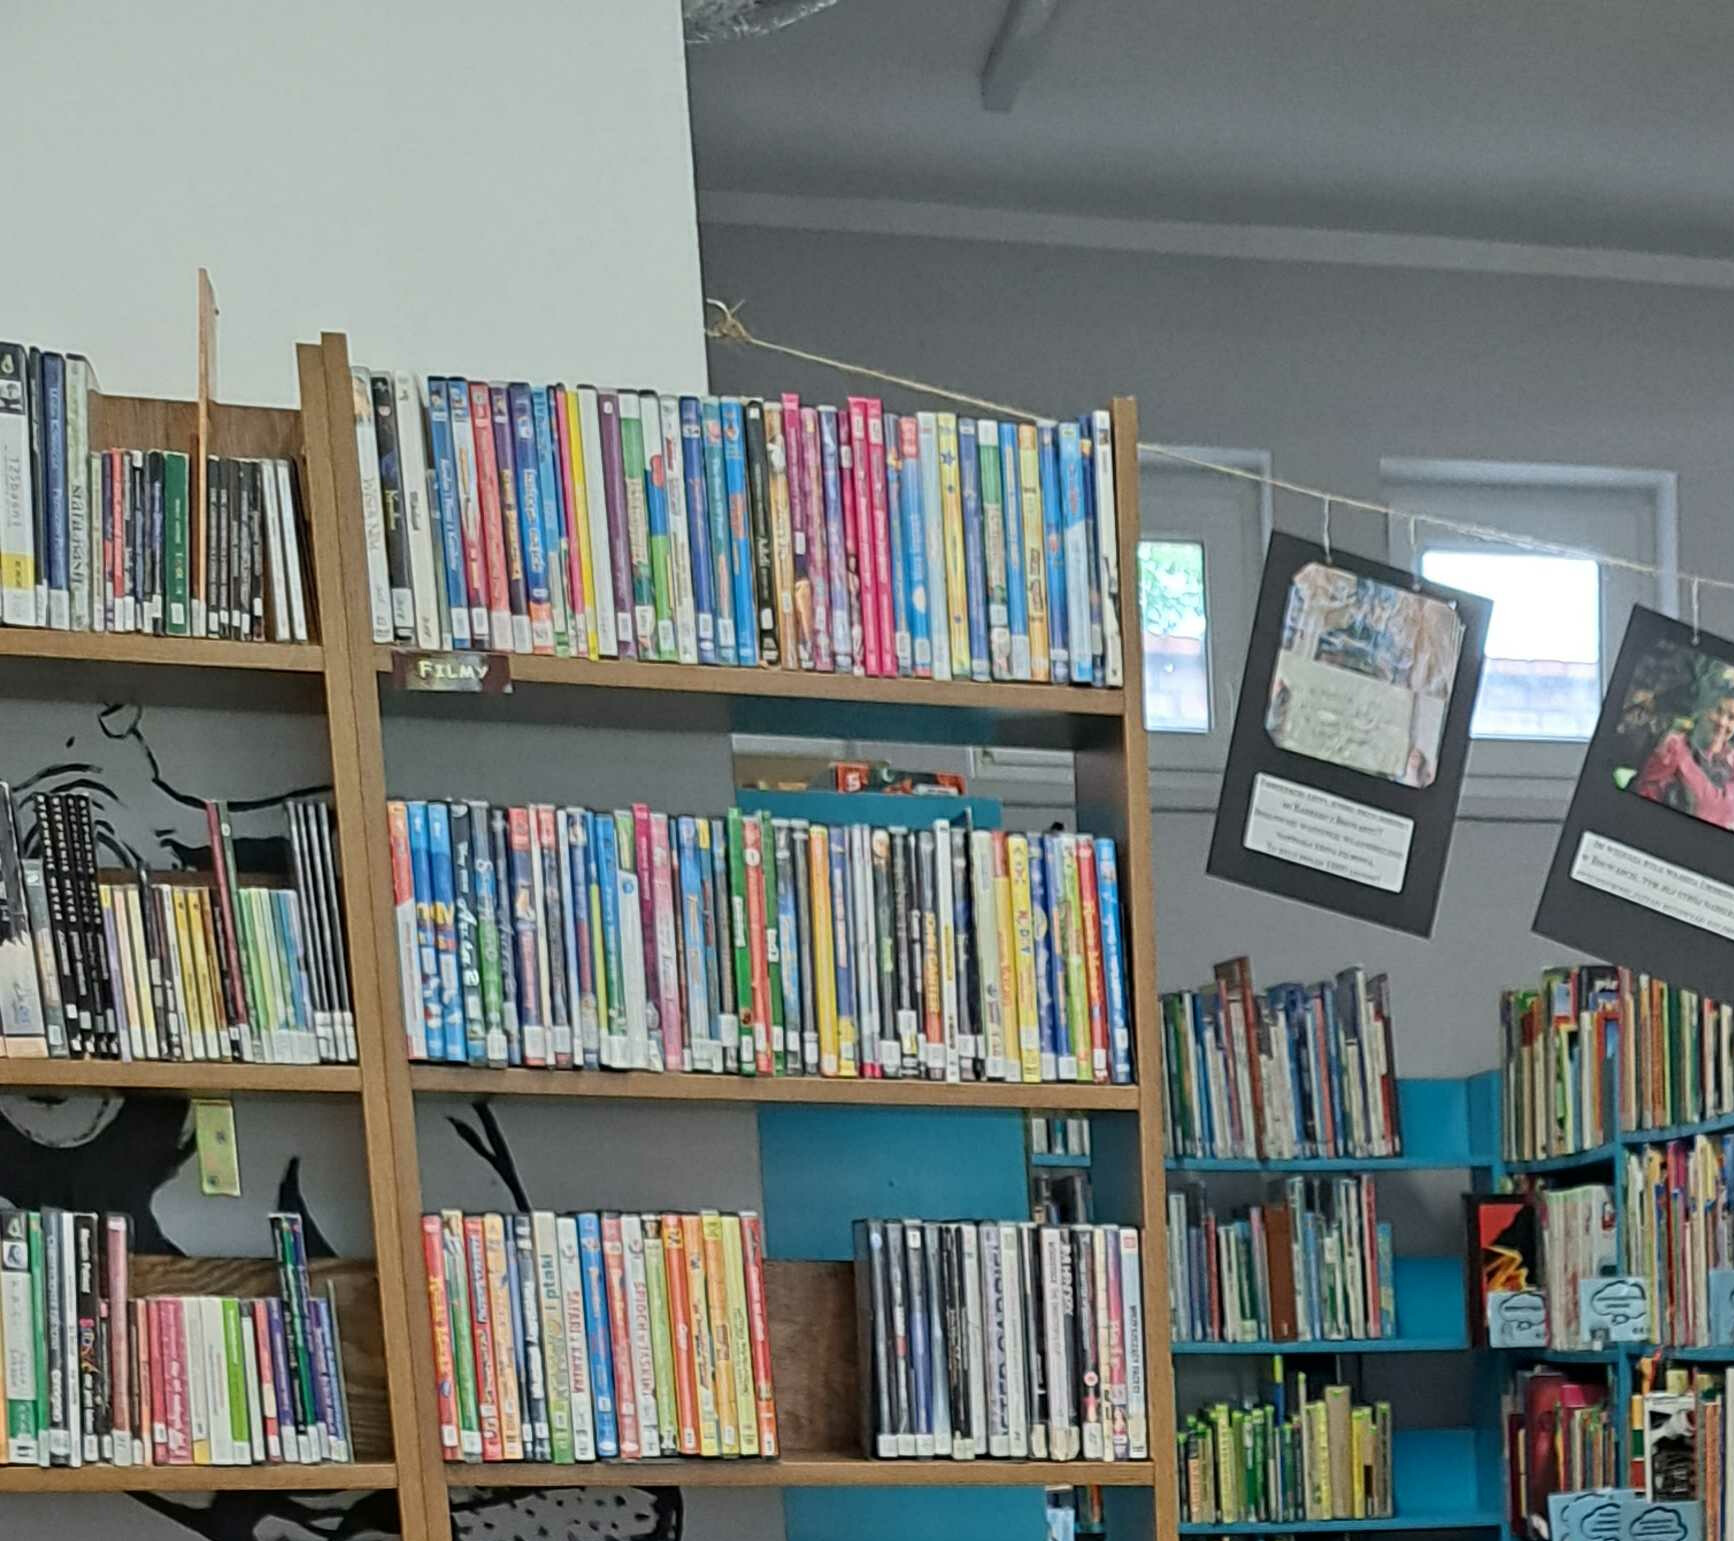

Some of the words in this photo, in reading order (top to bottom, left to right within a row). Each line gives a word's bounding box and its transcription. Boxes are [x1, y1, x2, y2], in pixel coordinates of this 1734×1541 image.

[418, 657, 491, 684] FILMY
[541, 1254, 560, 1300] ptaki
[566, 1290, 582, 1334] SAFARI
